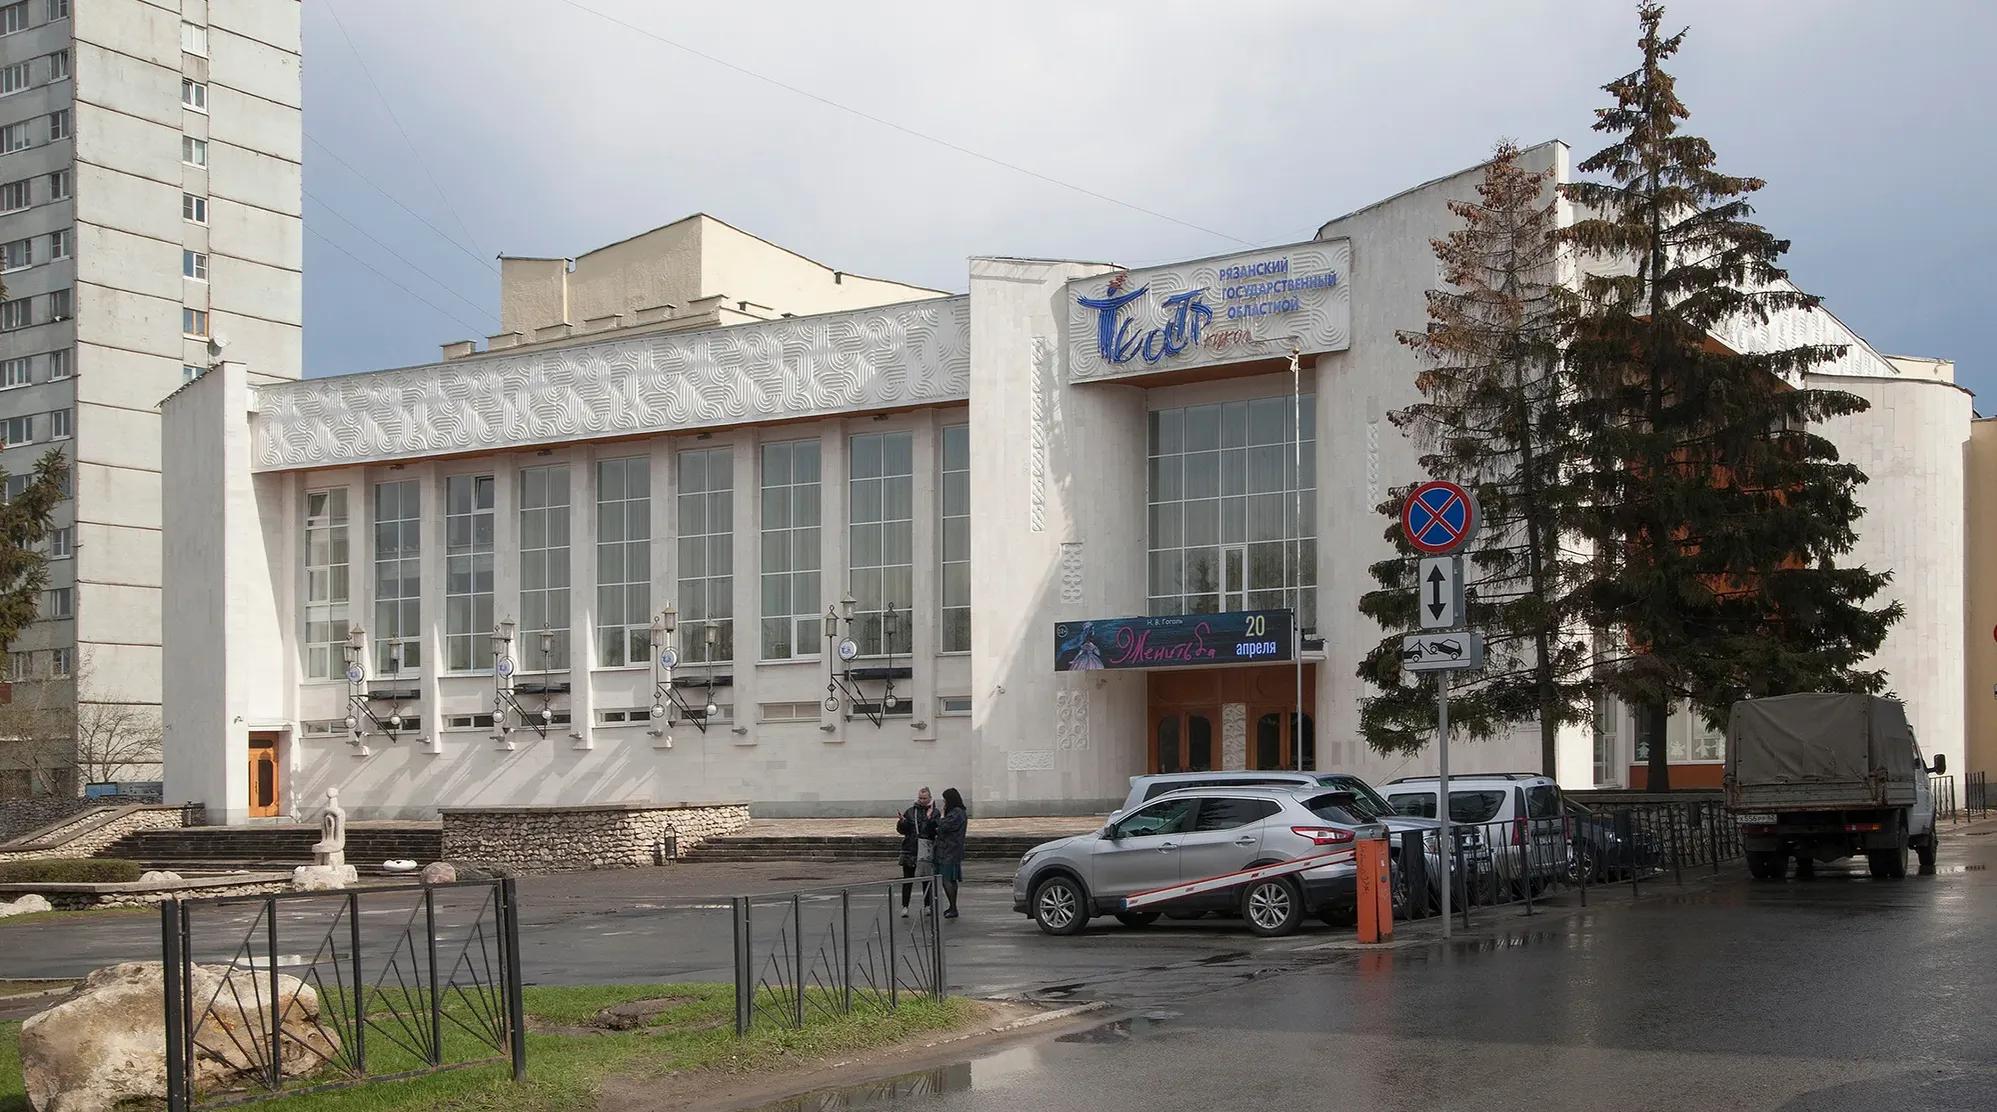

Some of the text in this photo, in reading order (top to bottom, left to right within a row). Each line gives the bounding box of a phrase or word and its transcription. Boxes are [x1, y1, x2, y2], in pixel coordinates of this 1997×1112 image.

[1219, 256, 1289, 281] РЯЗАНСКИЙ
[1222, 270, 1337, 300] ГОСУДАРСТВЕННЫЙ
[1227, 295, 1300, 320] ОБЛАСТНОЙ
[1245, 615, 1265, 636] 20
[1110, 622, 1216, 664] Женитьба
[1236, 641, 1276, 658] апреля
